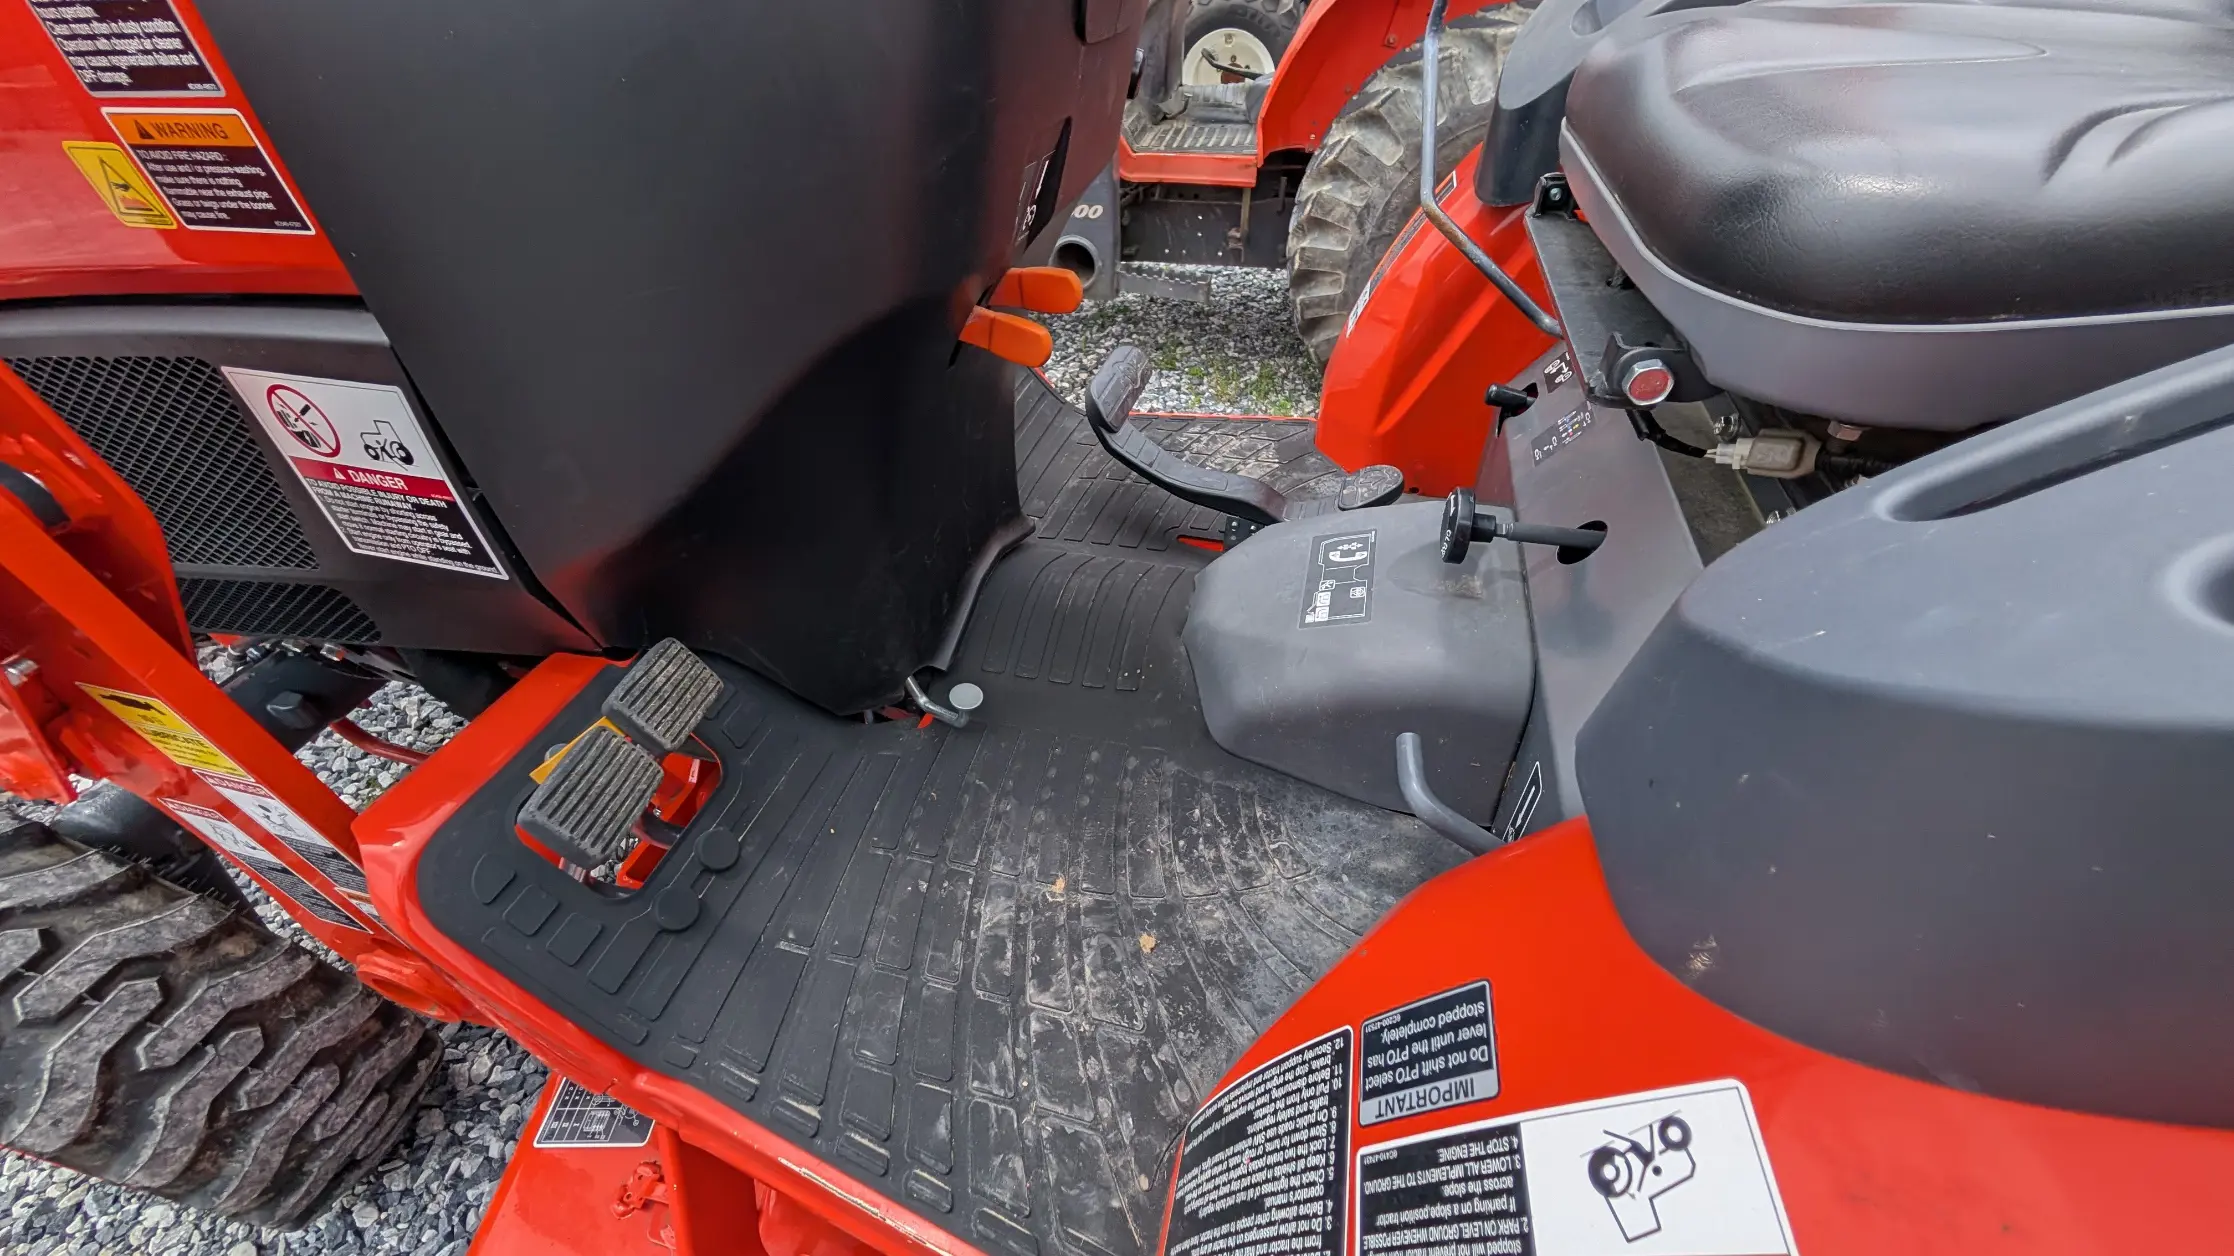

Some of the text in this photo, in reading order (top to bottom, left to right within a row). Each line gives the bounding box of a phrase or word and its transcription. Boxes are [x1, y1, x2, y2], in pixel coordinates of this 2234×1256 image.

[152, 123, 228, 138] WARNING
[348, 470, 407, 489] DANGER
[312, 487, 333, 495] FROM
[340, 492, 374, 502] MACHINE
[374, 498, 415, 509] RUNAWAY.
[340, 484, 377, 496] POSSIBLE
[378, 491, 404, 500] INJURY
[419, 498, 446, 507] DEATH
[1365, 1014, 1401, 1033] 6C200-47531
[1381, 1001, 1484, 1045] stopped completely.
[1367, 1023, 1487, 1068] lever until the PTO has
[1263, 1037, 1344, 1080] 12. Securely support tractor
[1365, 1045, 1489, 1091] Do not shift PTO select
[1255, 1054, 1331, 1097] brake, stop the engine and
[1256, 1063, 1343, 1106] 11. Before dismounting, lower
[1253, 1077, 1342, 1120] 10. Pull only from the drawbar.
[1375, 1077, 1474, 1119] IMPORTANT
[1247, 1095, 1328, 1135] traffic and safety regulations.
[1266, 1105, 1337, 1139] 9. On public roads use
[1257, 1120, 1336, 1155] 8. Slow down for turns, or
[1248, 1136, 1335, 1173] 7. Lock the two brake pedals
[1436, 1135, 1518, 1163] 4. STOP THE ENGINE.
[1251, 1151, 1335, 1185] 6. Keep all shields in place
[1363, 1154, 1521, 1195] 3. LOWER ALL IMPLEMENTS TO THE GROUND.
[1254, 1167, 1334, 1199] 5. Check the tightness of
[1441, 1175, 1514, 1198] across the slope.
[1264, 1183, 1324, 1211] operator's manual.
[1474, 1194, 1508, 1215] parking
[1509, 1196, 1516, 1213] If
[1221, 1199, 1333, 1235] 4. Before allowing other people to use
[1453, 1204, 1459, 1216] a
[1461, 1202, 1472, 1215] on
[1236, 1216, 1332, 1244] 3. Do not allow passengers on
[1375, 1212, 1399, 1228] tractor
[1460, 1221, 1484, 1239] LEVEL
[1484, 1220, 1496, 1236] ON
[1497, 1218, 1520, 1235] PARK
[1520, 1217, 1529, 1233] 2.
[1305, 1235, 1321, 1249] from
[1391, 1227, 1428, 1247] WHENEVER
[1429, 1224, 1459, 1242] GROUND
[1256, 1243, 1268, 1255] and
[1269, 1239, 1290, 1253] tractor
[1292, 1237, 1303, 1251] the
[1428, 1242, 1456, 1256] prevent
[1458, 1244, 1470, 1256] not
[1472, 1243, 1485, 1256] will
[1487, 1237, 1522, 1256] stopped
